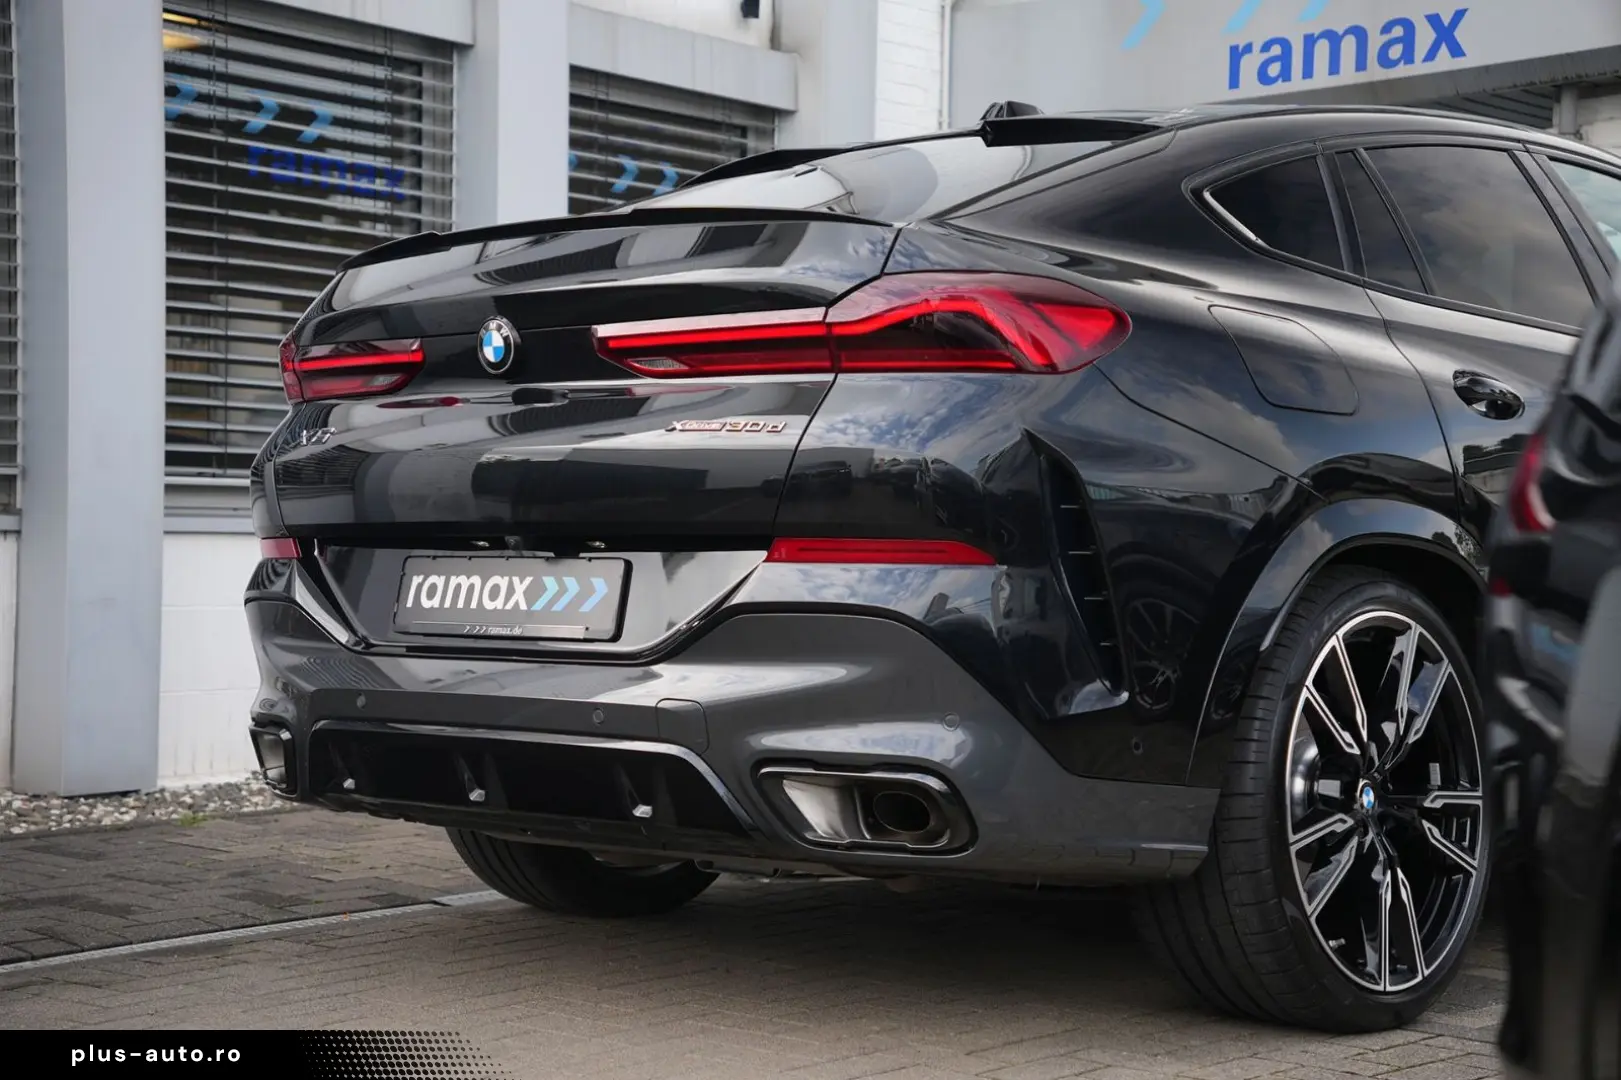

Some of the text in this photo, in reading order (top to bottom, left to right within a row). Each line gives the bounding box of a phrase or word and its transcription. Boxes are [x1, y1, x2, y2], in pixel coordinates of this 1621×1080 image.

[1228, 7, 1470, 90] ramax
[248, 145, 405, 200] ramax
[406, 573, 534, 611] ramax
